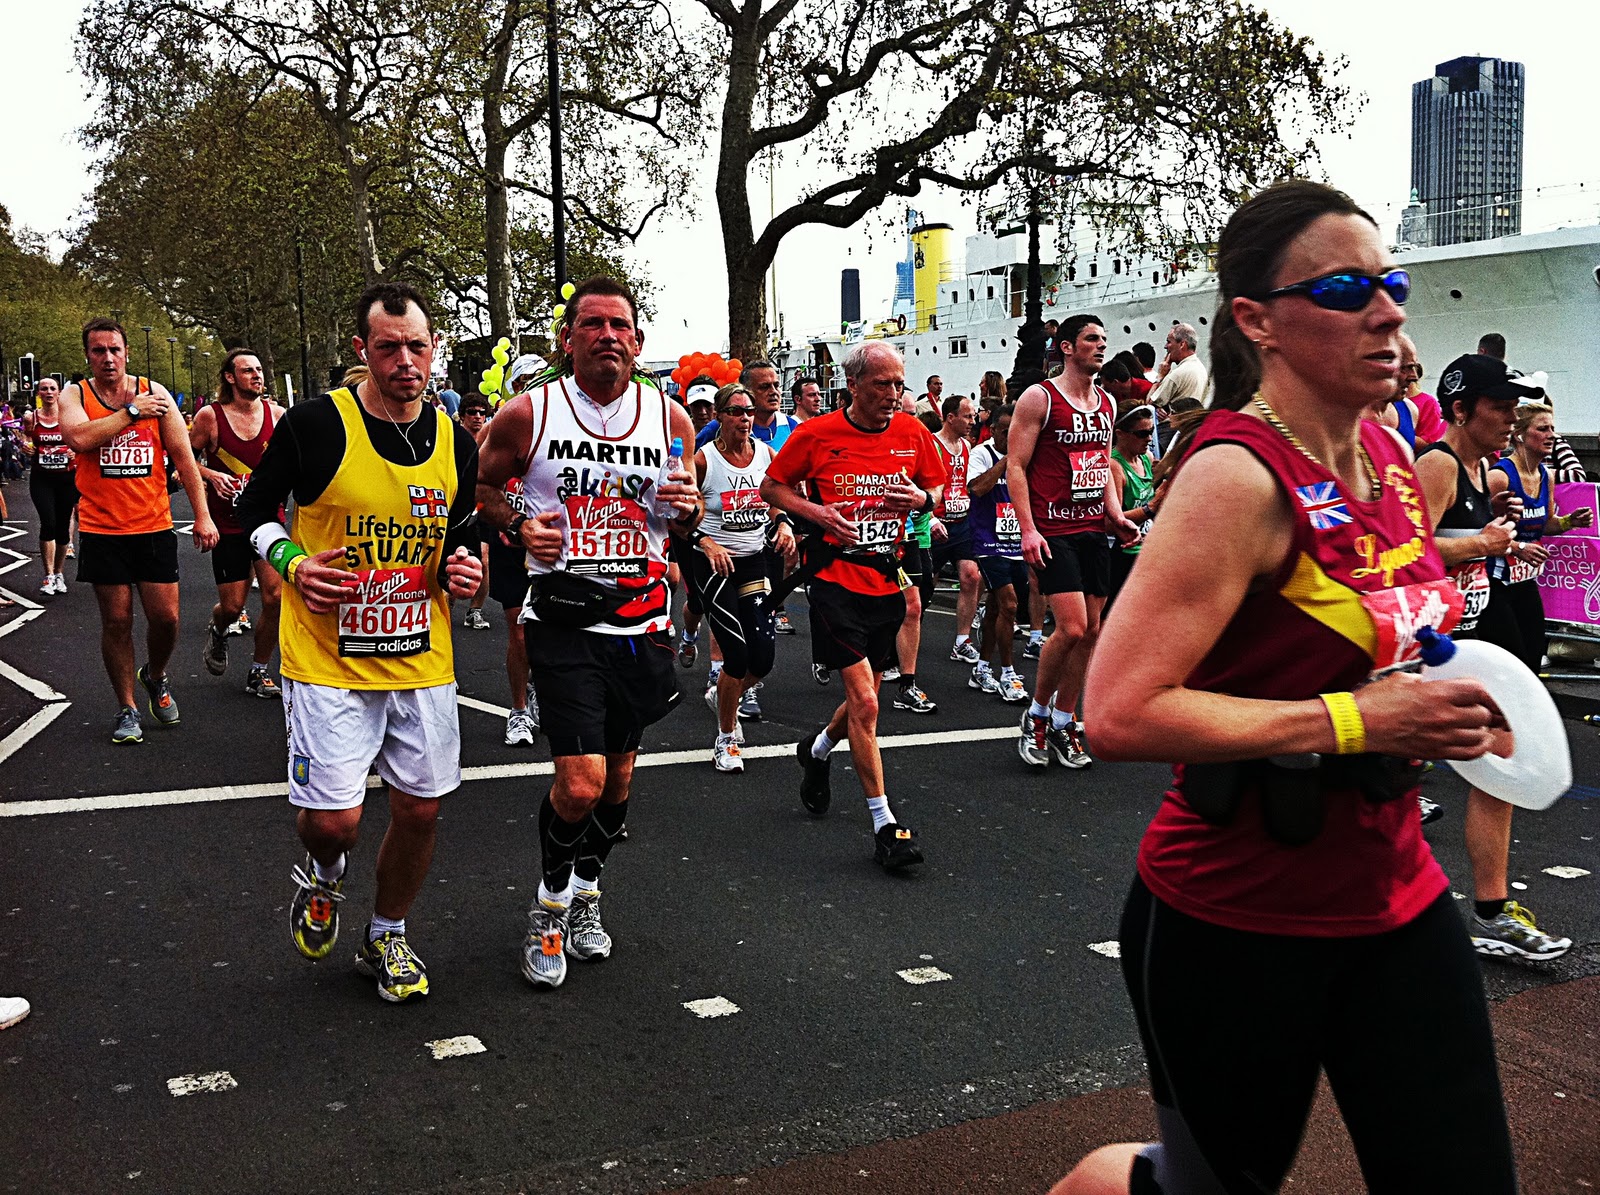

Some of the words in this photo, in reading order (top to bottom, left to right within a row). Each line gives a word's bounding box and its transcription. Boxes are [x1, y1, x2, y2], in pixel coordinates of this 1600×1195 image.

[1072, 411, 1112, 432] BEN
[101, 448, 151, 465] 50781
[547, 439, 661, 468] MARTIN
[121, 467, 148, 475] adidas
[856, 473, 900, 485] MARATÓ
[727, 475, 759, 489] VAL
[576, 496, 626, 530] Virgin
[345, 515, 446, 540] Lifeboats
[610, 519, 644, 528] money
[857, 521, 899, 543] 1542
[569, 531, 646, 557] 45180
[1542, 541, 1589, 560] east
[344, 540, 436, 569] STUART
[600, 563, 639, 573] adidas
[1543, 559, 1596, 575] ancer
[356, 569, 410, 606] Virgin
[1535, 574, 1576, 590] care
[393, 589, 426, 600] money
[341, 602, 428, 634] 46044
[377, 638, 422, 652] adidas
